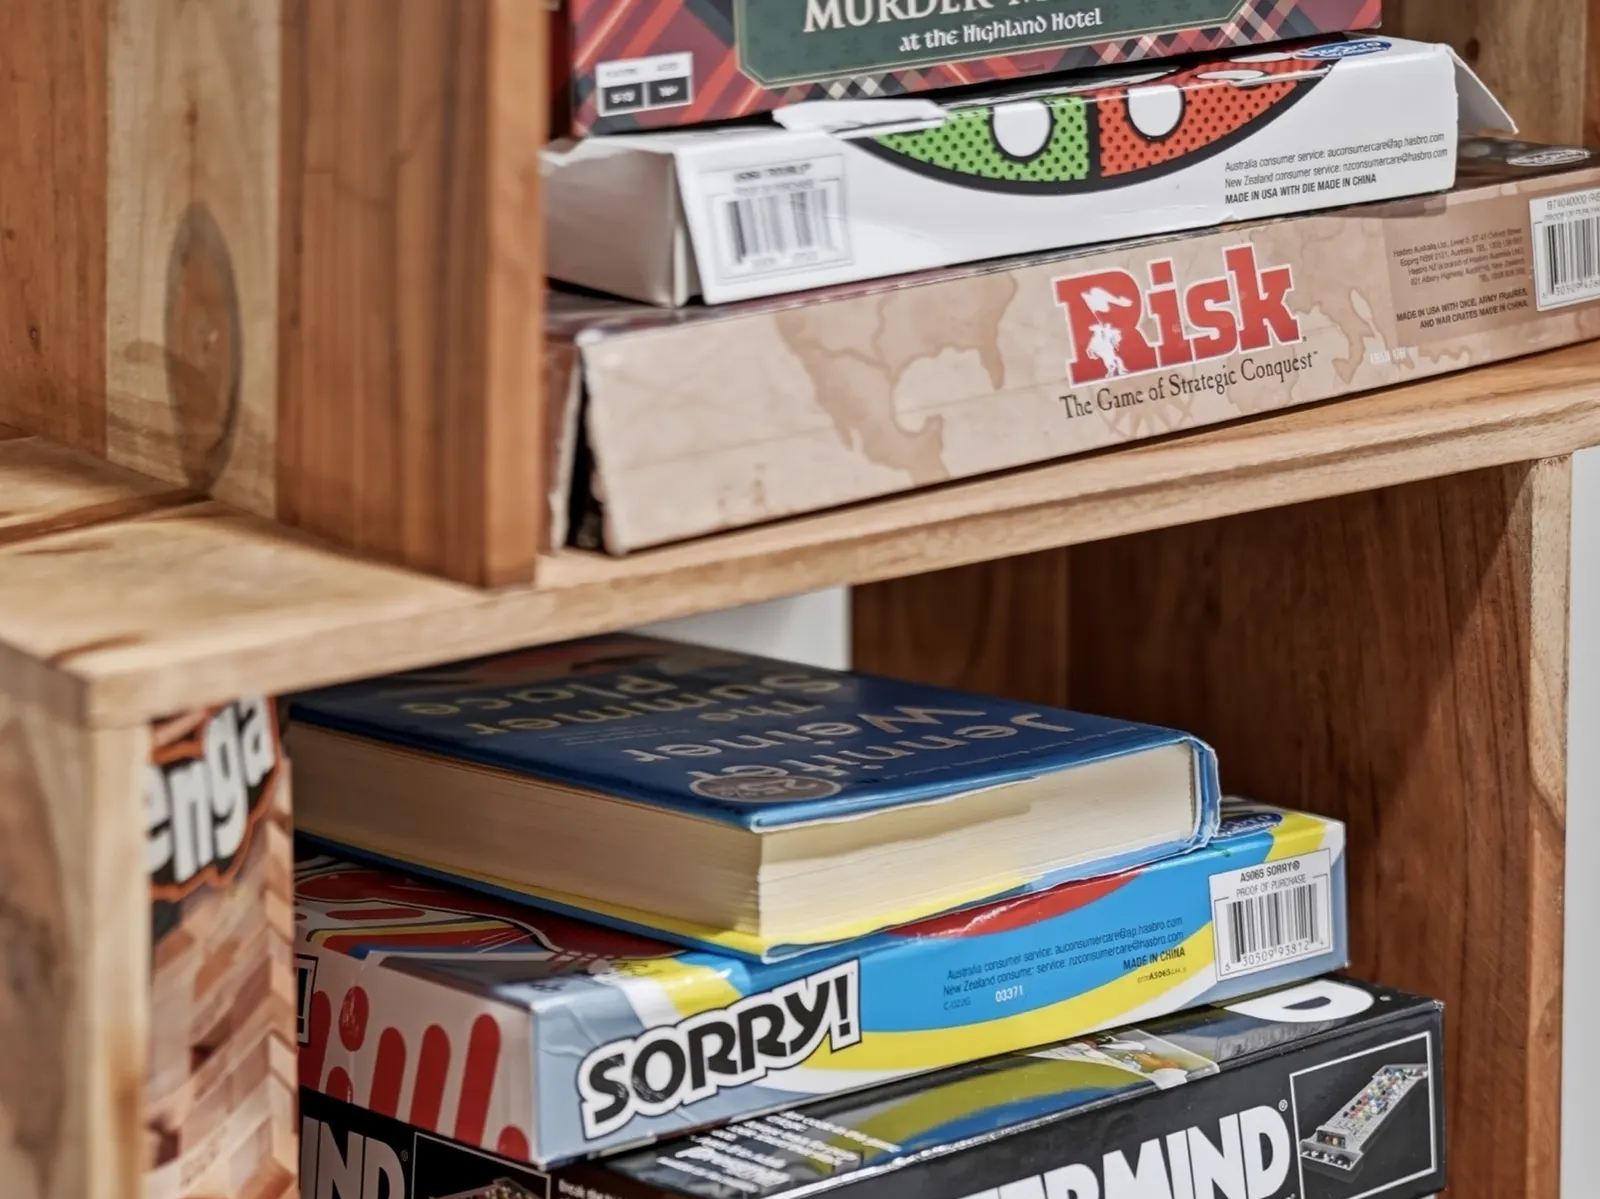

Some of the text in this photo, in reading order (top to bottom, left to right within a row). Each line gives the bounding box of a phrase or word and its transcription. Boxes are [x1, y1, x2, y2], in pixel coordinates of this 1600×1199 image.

[803, 0, 996, 32] MURD
[899, 7, 1103, 52] at the Highland Hotel
[1225, 158, 1258, 172] Australia
[1259, 154, 1296, 169] consumer
[1297, 149, 1326, 163] service:
[1225, 177, 1242, 189] New
[1244, 171, 1274, 186] Zealand
[1275, 166, 1311, 182] consumer
[1312, 162, 1342, 177] service:
[1225, 172, 1378, 205] MADE IN USA WITH DIE MADE IN CHINA
[1053, 244, 1301, 386] Risk
[1060, 394, 1093, 419] The
[1097, 385, 1144, 412] Game
[1148, 377, 1165, 399] of
[1169, 364, 1238, 396] Strategic
[400, 674, 678, 716] Place
[466, 674, 842, 736] Summer
[698, 700, 826, 722] The
[622, 705, 987, 763] Weiner
[1236, 873, 1307, 898] PROOF OF PURCHASE
[947, 963, 983, 981] Australia
[984, 953, 1022, 972] consumer
[1123, 947, 1186, 971] MADE IN CHINA
[943, 982, 962, 997] New
[964, 975, 996, 993] Zealand
[994, 984, 1024, 1003] 03371
[586, 972, 853, 1127] SORRY!
